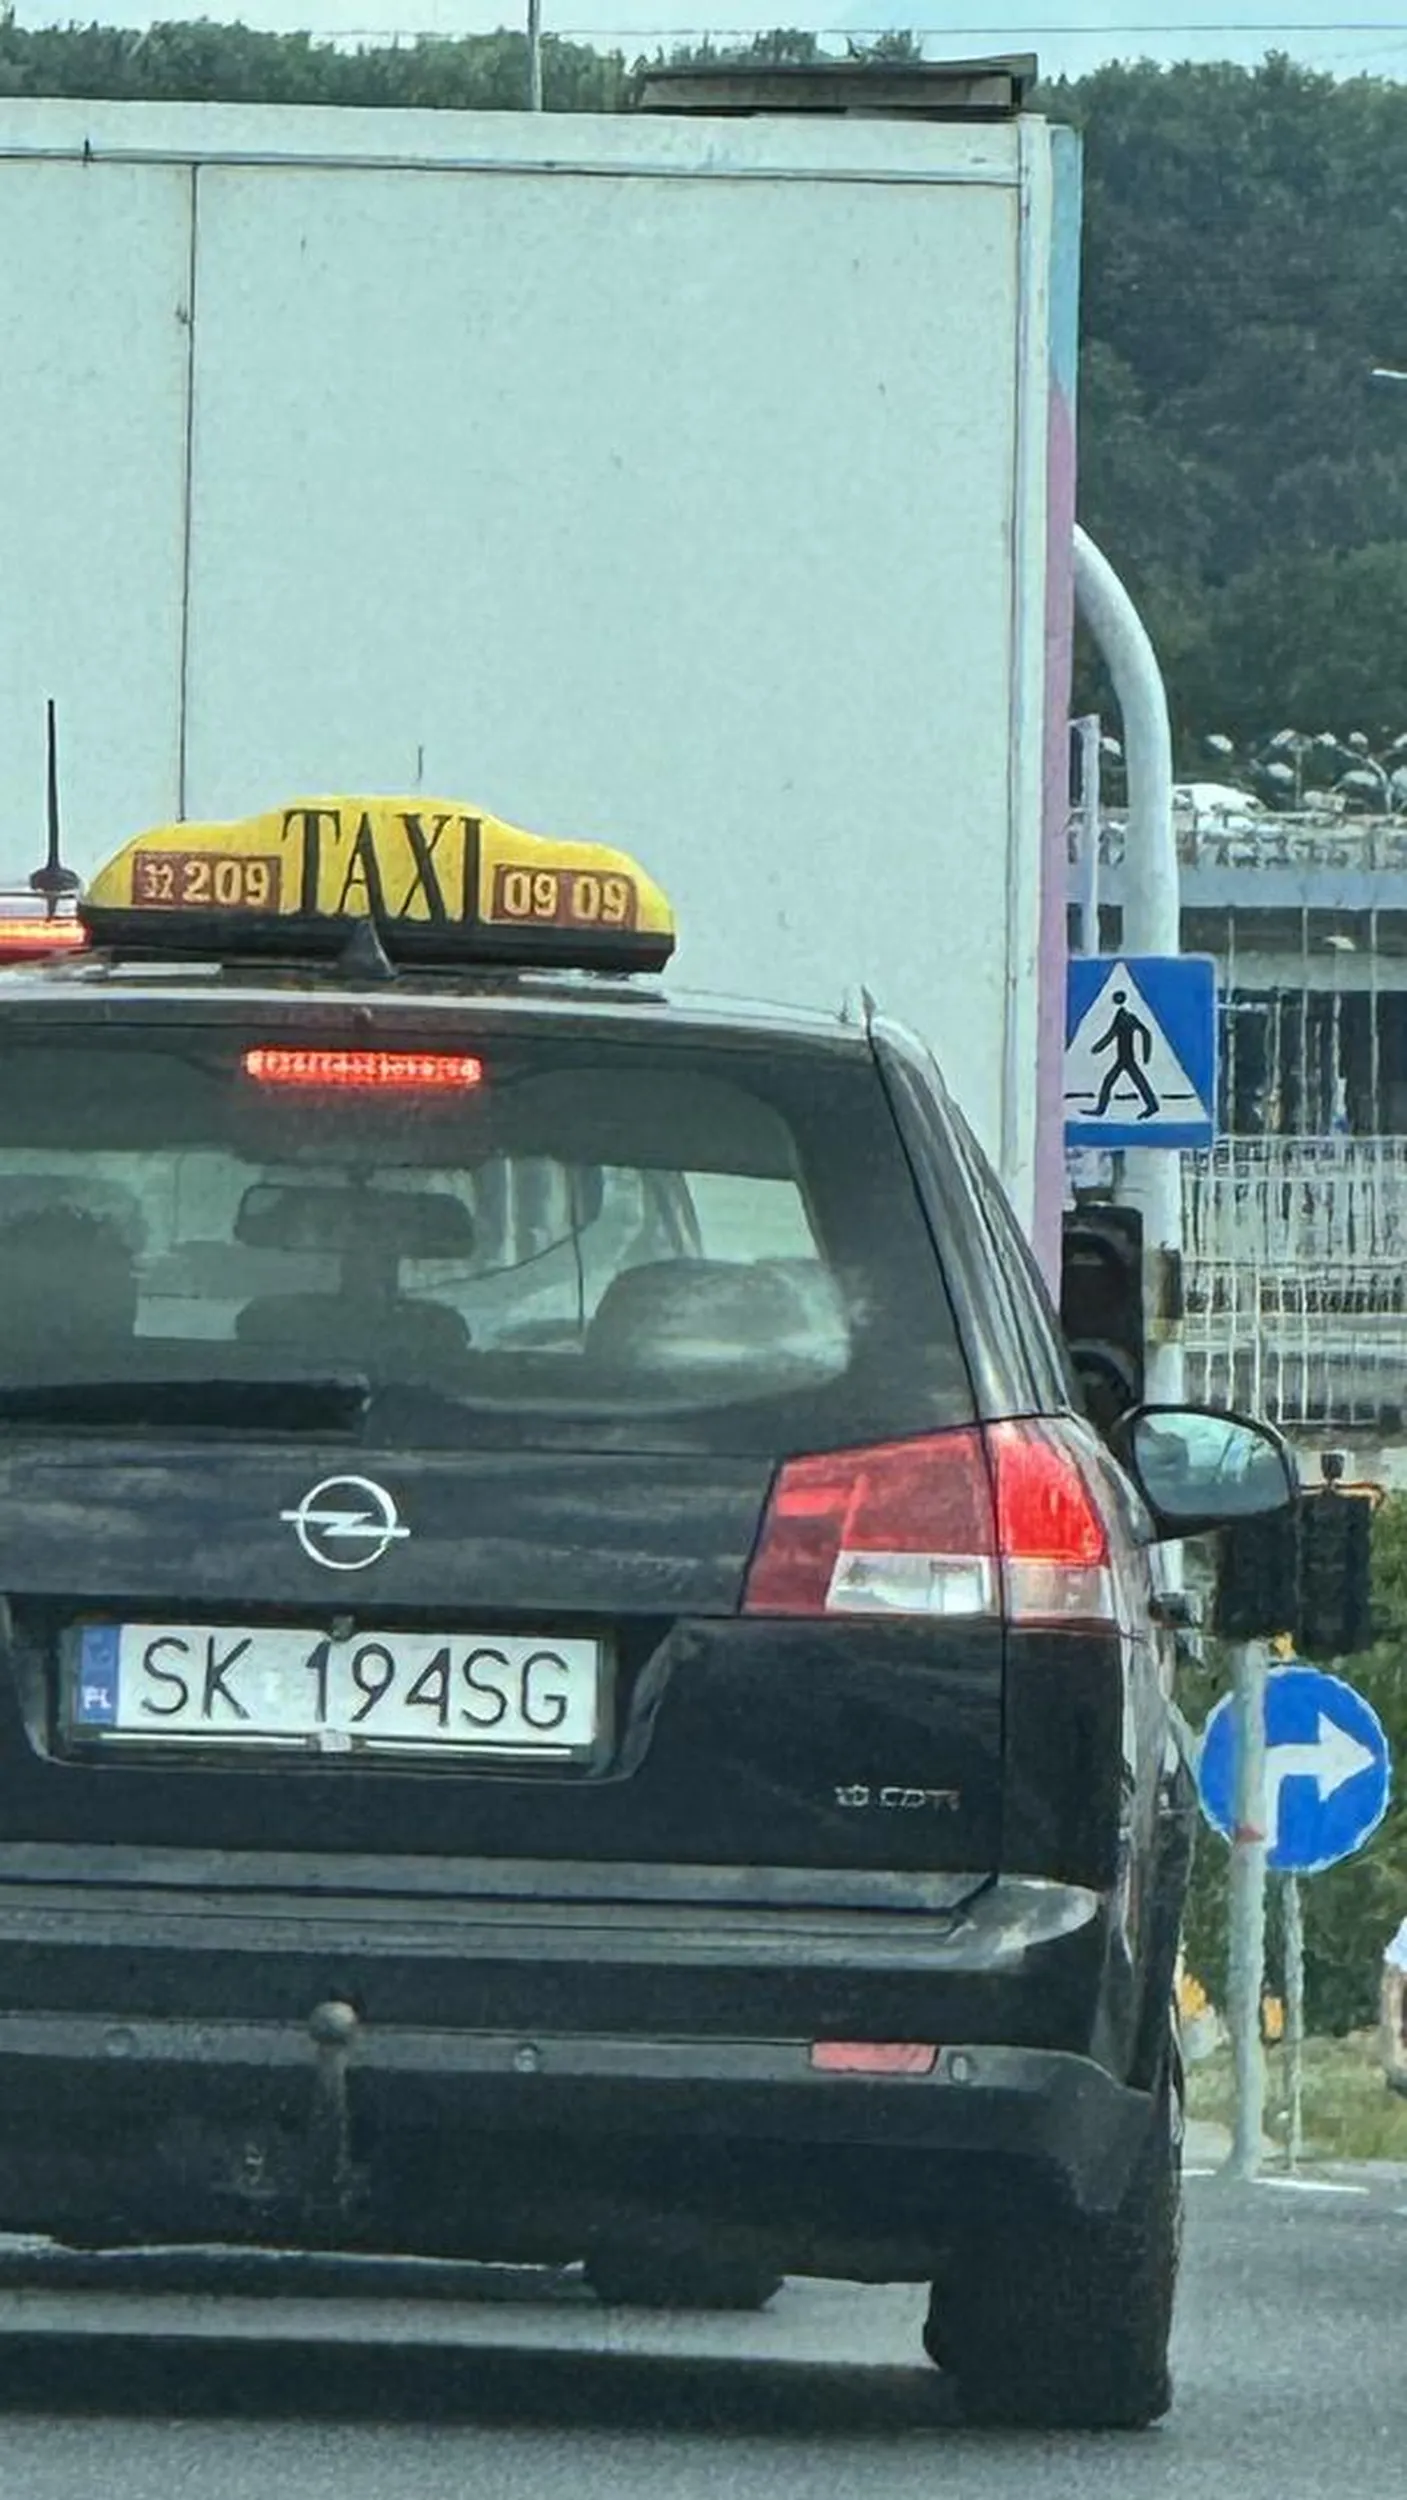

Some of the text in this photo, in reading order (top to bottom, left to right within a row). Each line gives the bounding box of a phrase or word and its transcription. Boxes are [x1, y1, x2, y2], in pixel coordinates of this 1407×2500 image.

[183, 860, 270, 905] 209
[281, 809, 481, 923] TAXI
[504, 872, 628, 922] 09 09
[140, 1636, 569, 1730] SK 194SG
